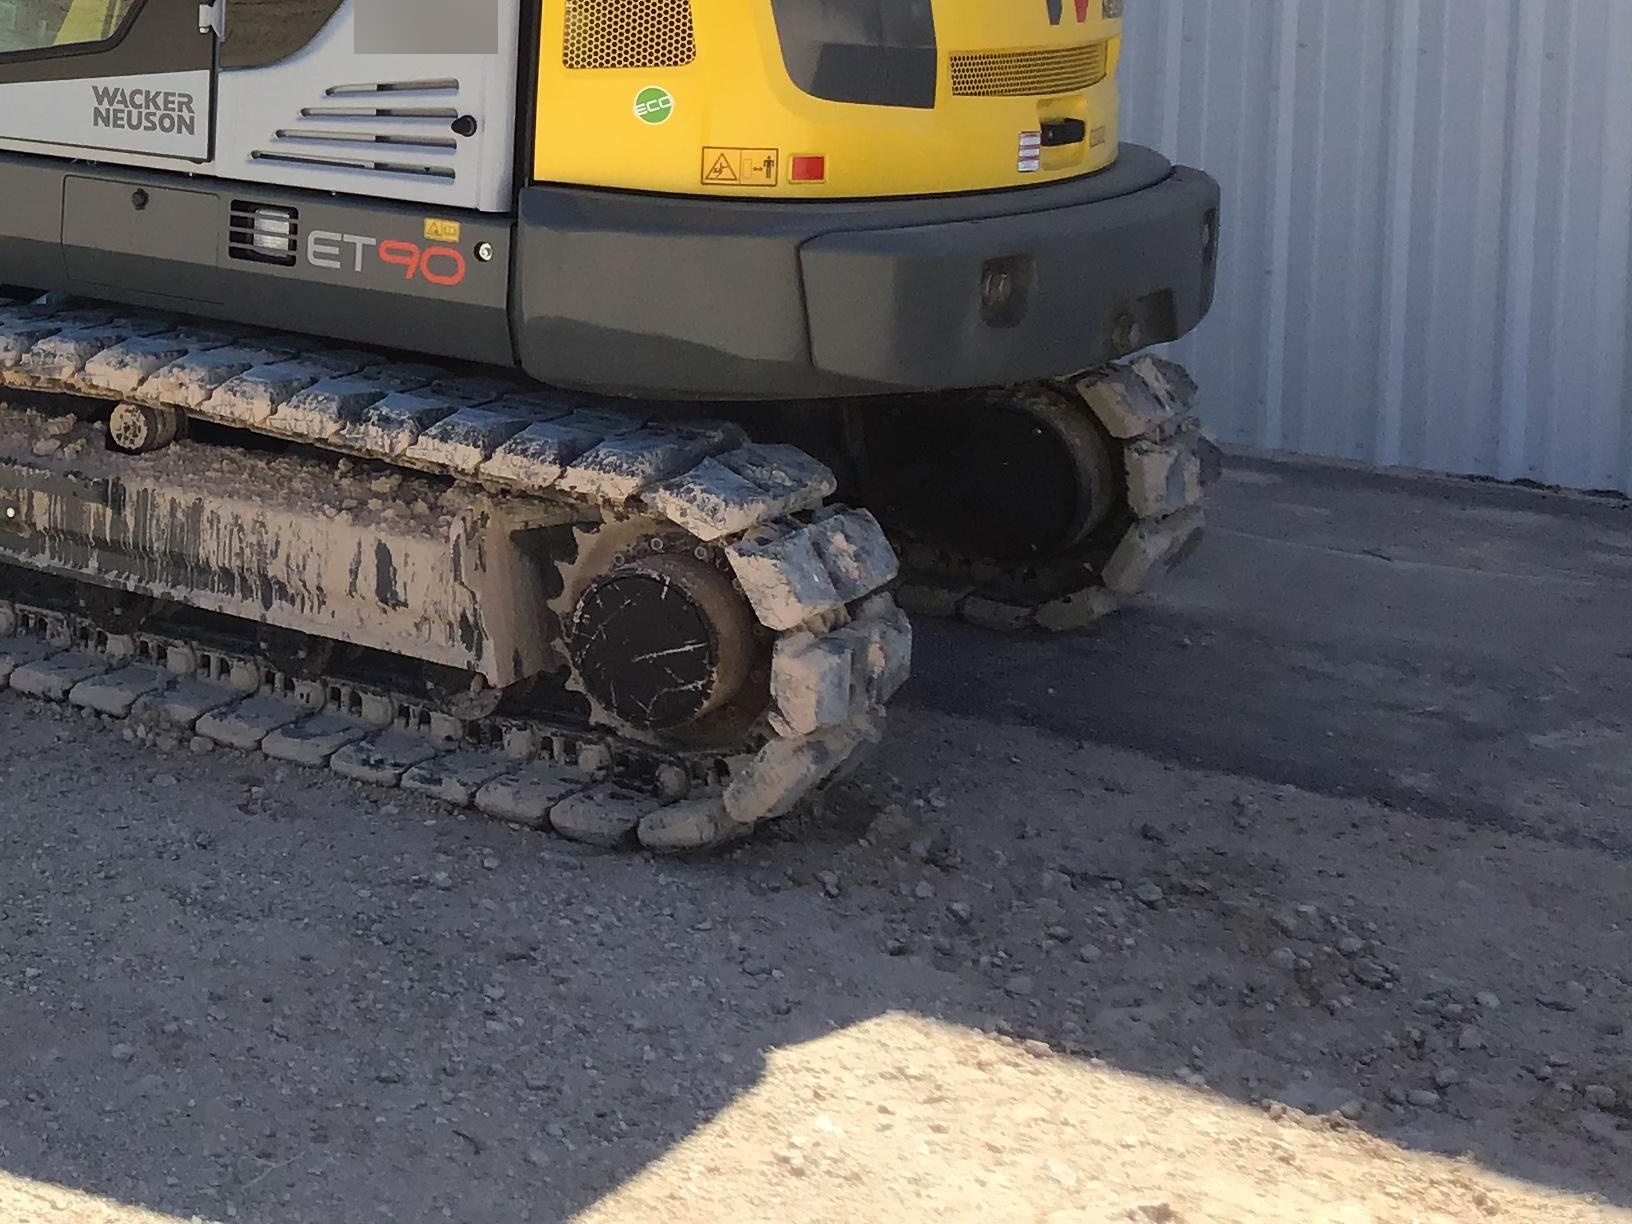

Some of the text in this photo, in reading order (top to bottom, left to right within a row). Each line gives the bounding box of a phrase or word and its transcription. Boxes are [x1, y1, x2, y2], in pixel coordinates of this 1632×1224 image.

[92, 85, 195, 114] WACKER
[635, 95, 673, 116] ECO
[93, 107, 195, 135] NEUSON
[307, 230, 465, 286] ET90
